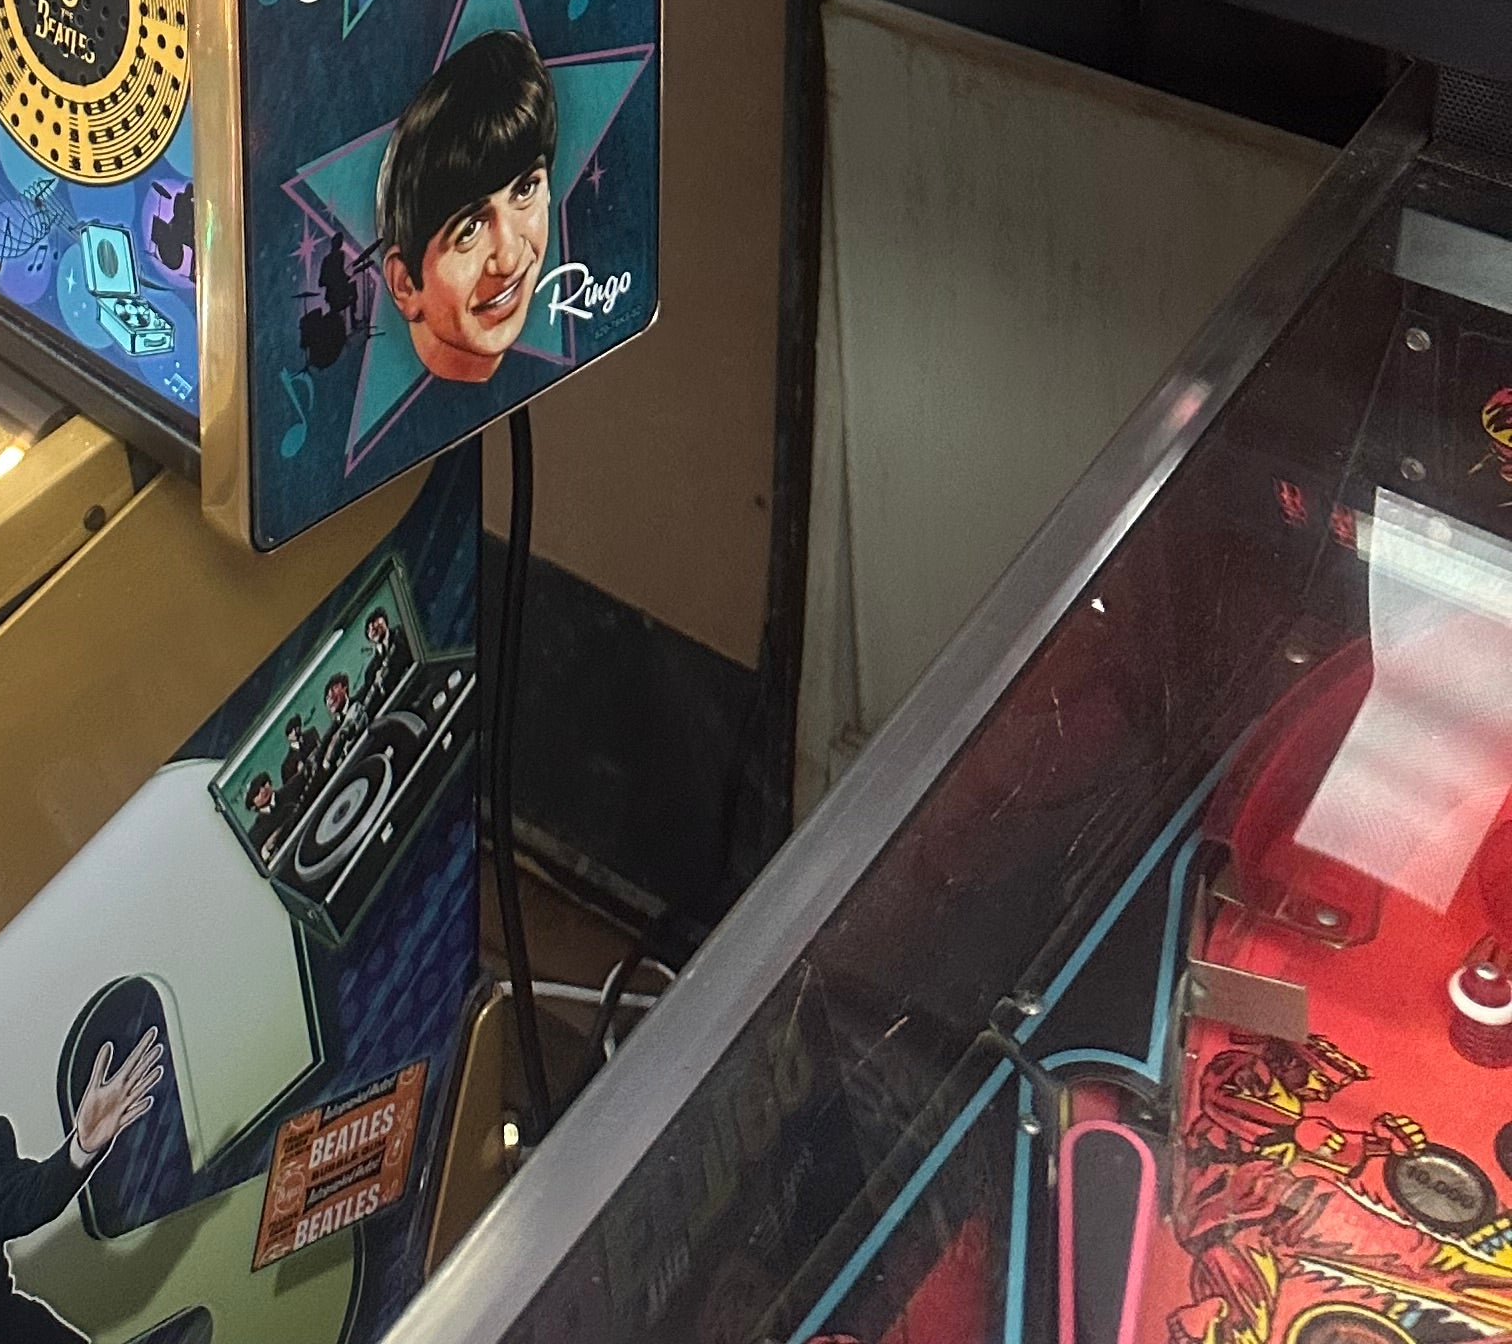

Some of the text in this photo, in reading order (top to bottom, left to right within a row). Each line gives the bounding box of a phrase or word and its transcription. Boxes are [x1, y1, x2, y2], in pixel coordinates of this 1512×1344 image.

[60, 8, 74, 23] THE
[535, 262, 632, 327] Ringo
[309, 1103, 395, 1169] BEATLES
[293, 1183, 381, 1250] BEATLES
